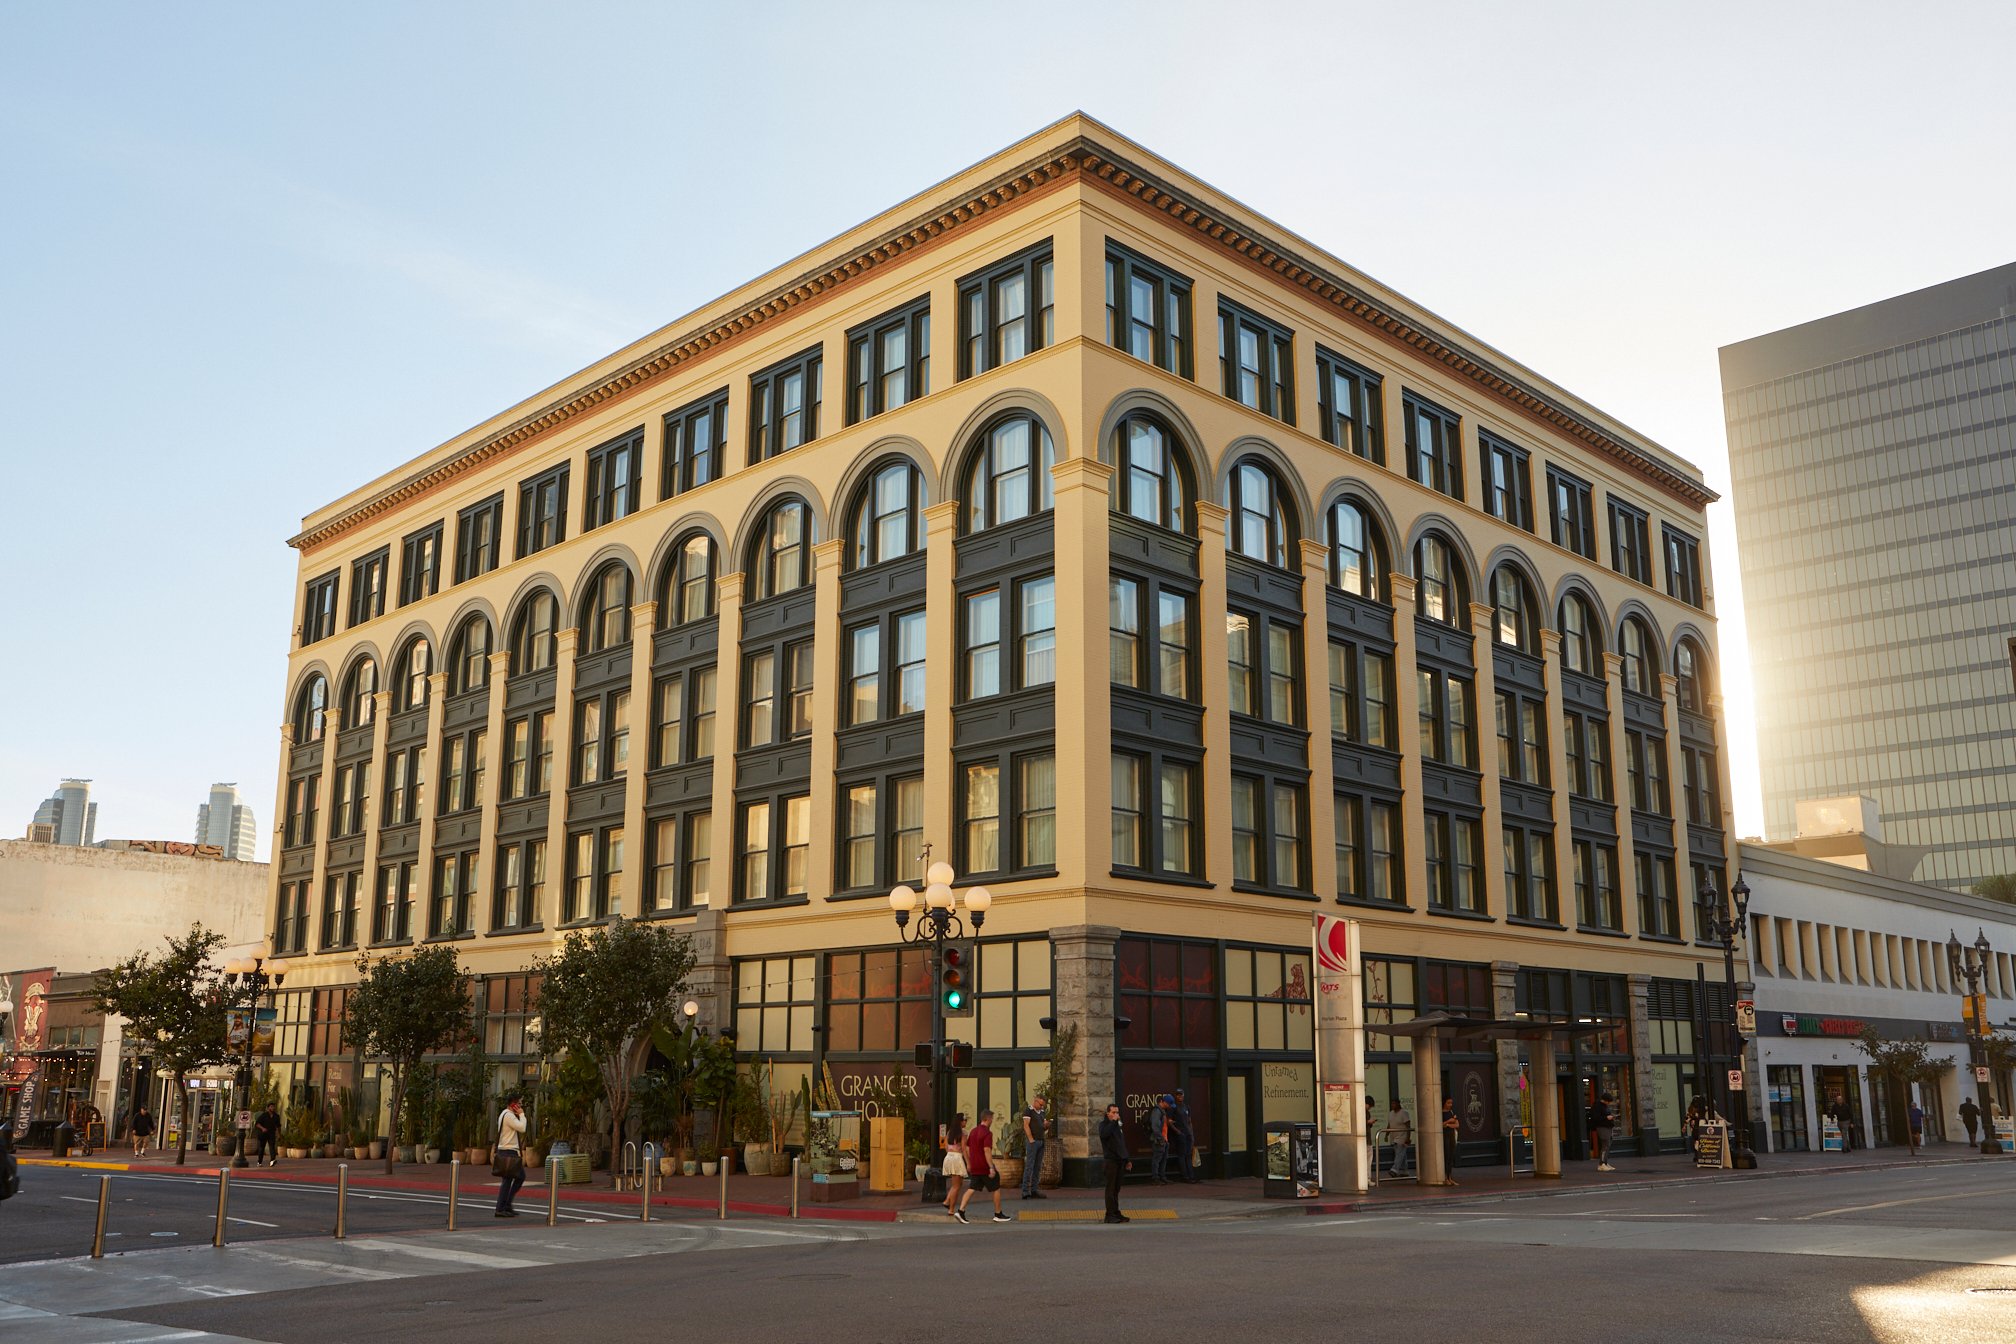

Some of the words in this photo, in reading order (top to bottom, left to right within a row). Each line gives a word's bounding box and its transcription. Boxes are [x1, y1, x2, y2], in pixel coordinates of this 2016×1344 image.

[1320, 983, 1340, 992] MTS
[1264, 1064, 1299, 1081] Untamed
[22, 1081, 36, 1103] SHOP
[1264, 1085, 1309, 1099] Refinement.
[18, 1106, 32, 1130] GAME
